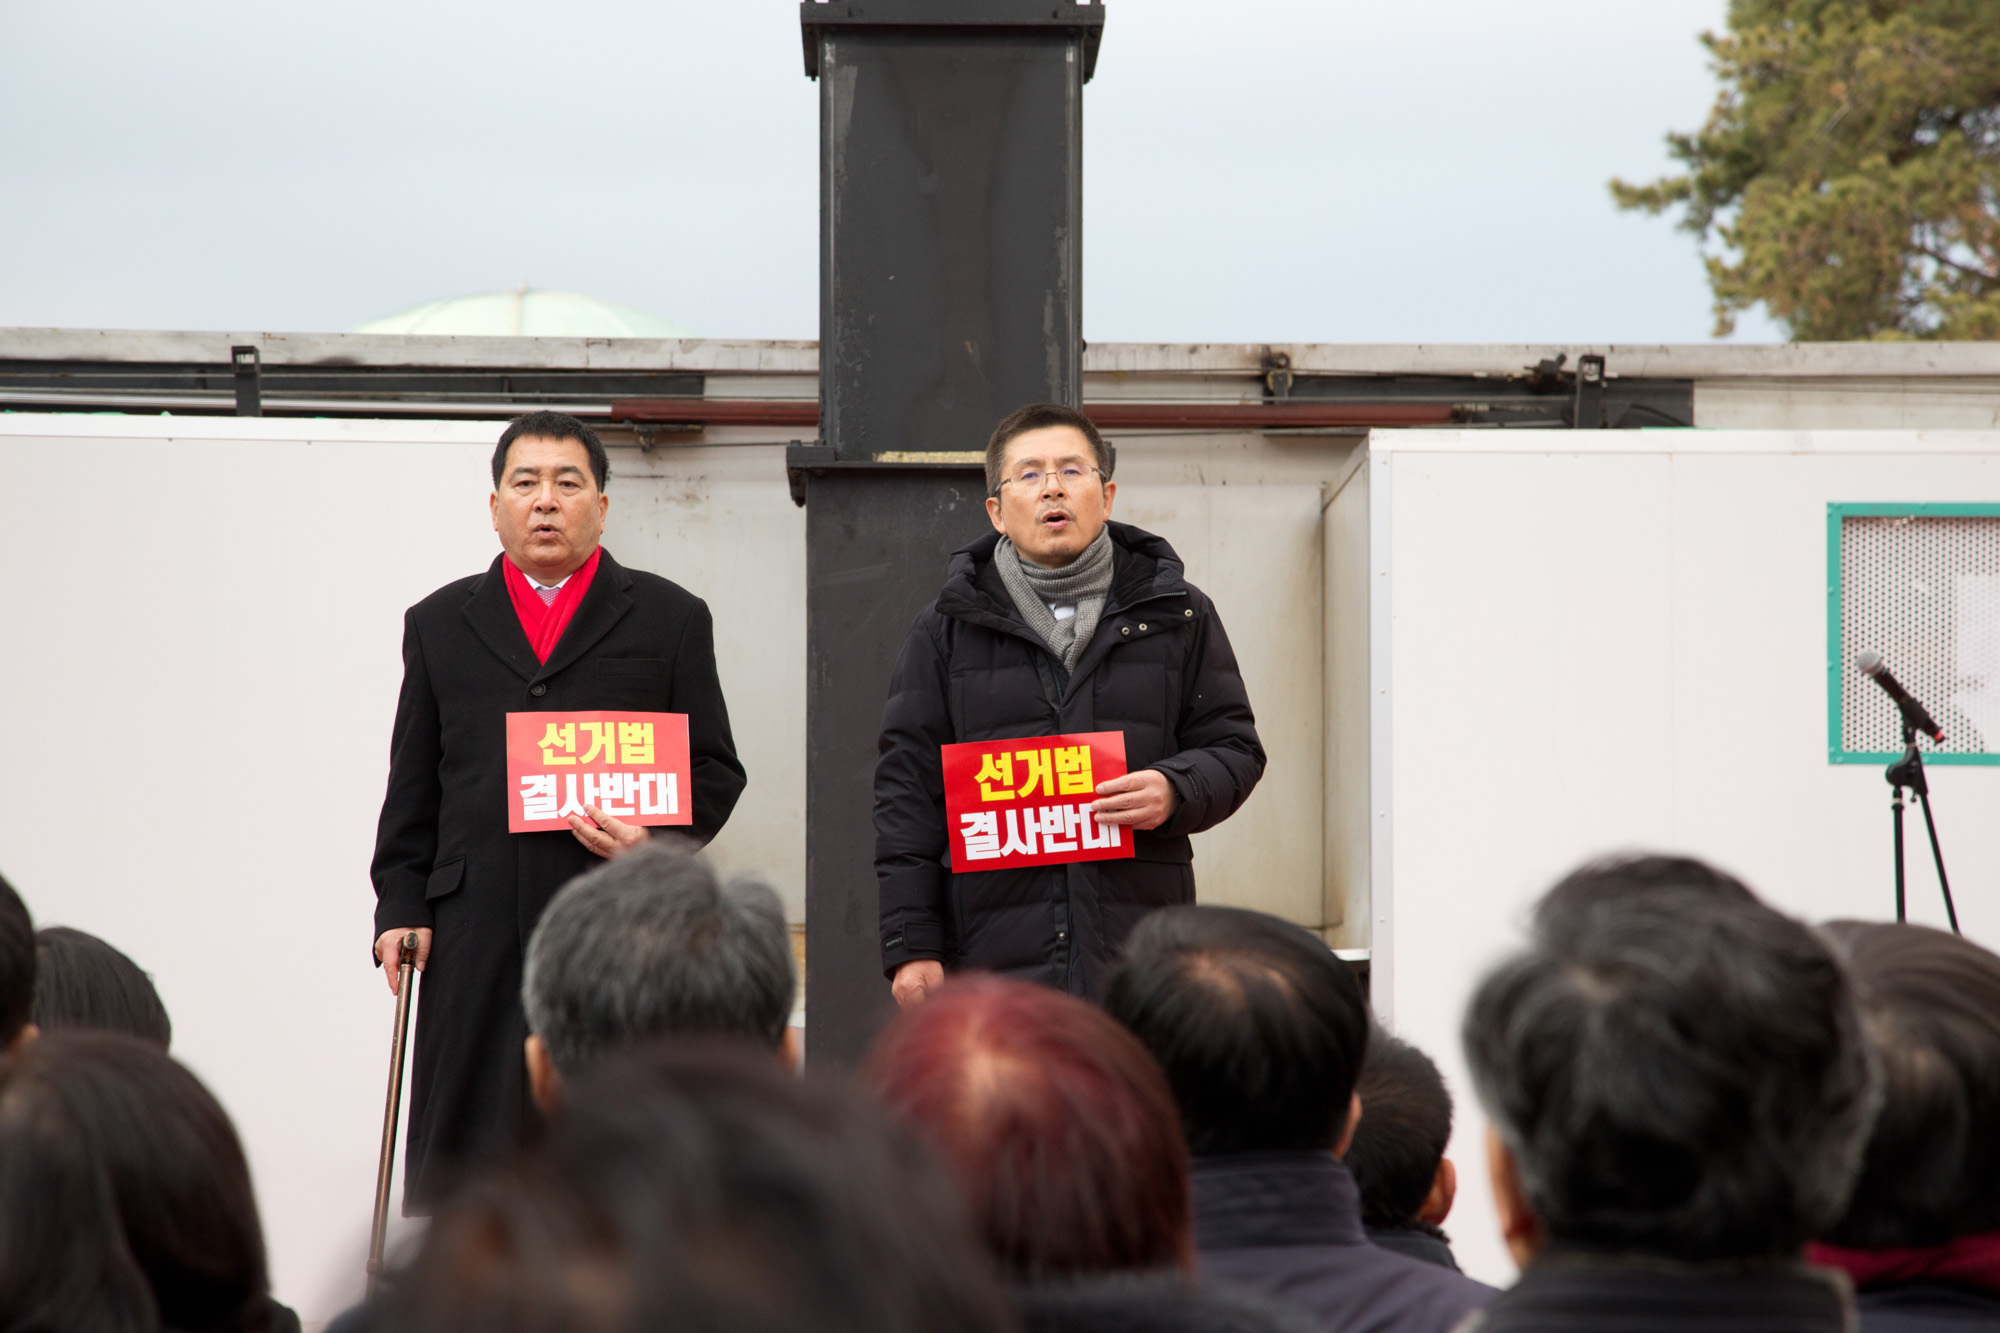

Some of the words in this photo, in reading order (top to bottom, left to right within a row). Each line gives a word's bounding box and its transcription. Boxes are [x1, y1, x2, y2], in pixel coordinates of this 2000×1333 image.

[536, 722, 655, 765] 선거법
[519, 773, 678, 821] 결사반대
[974, 745, 1094, 801] 선거법
